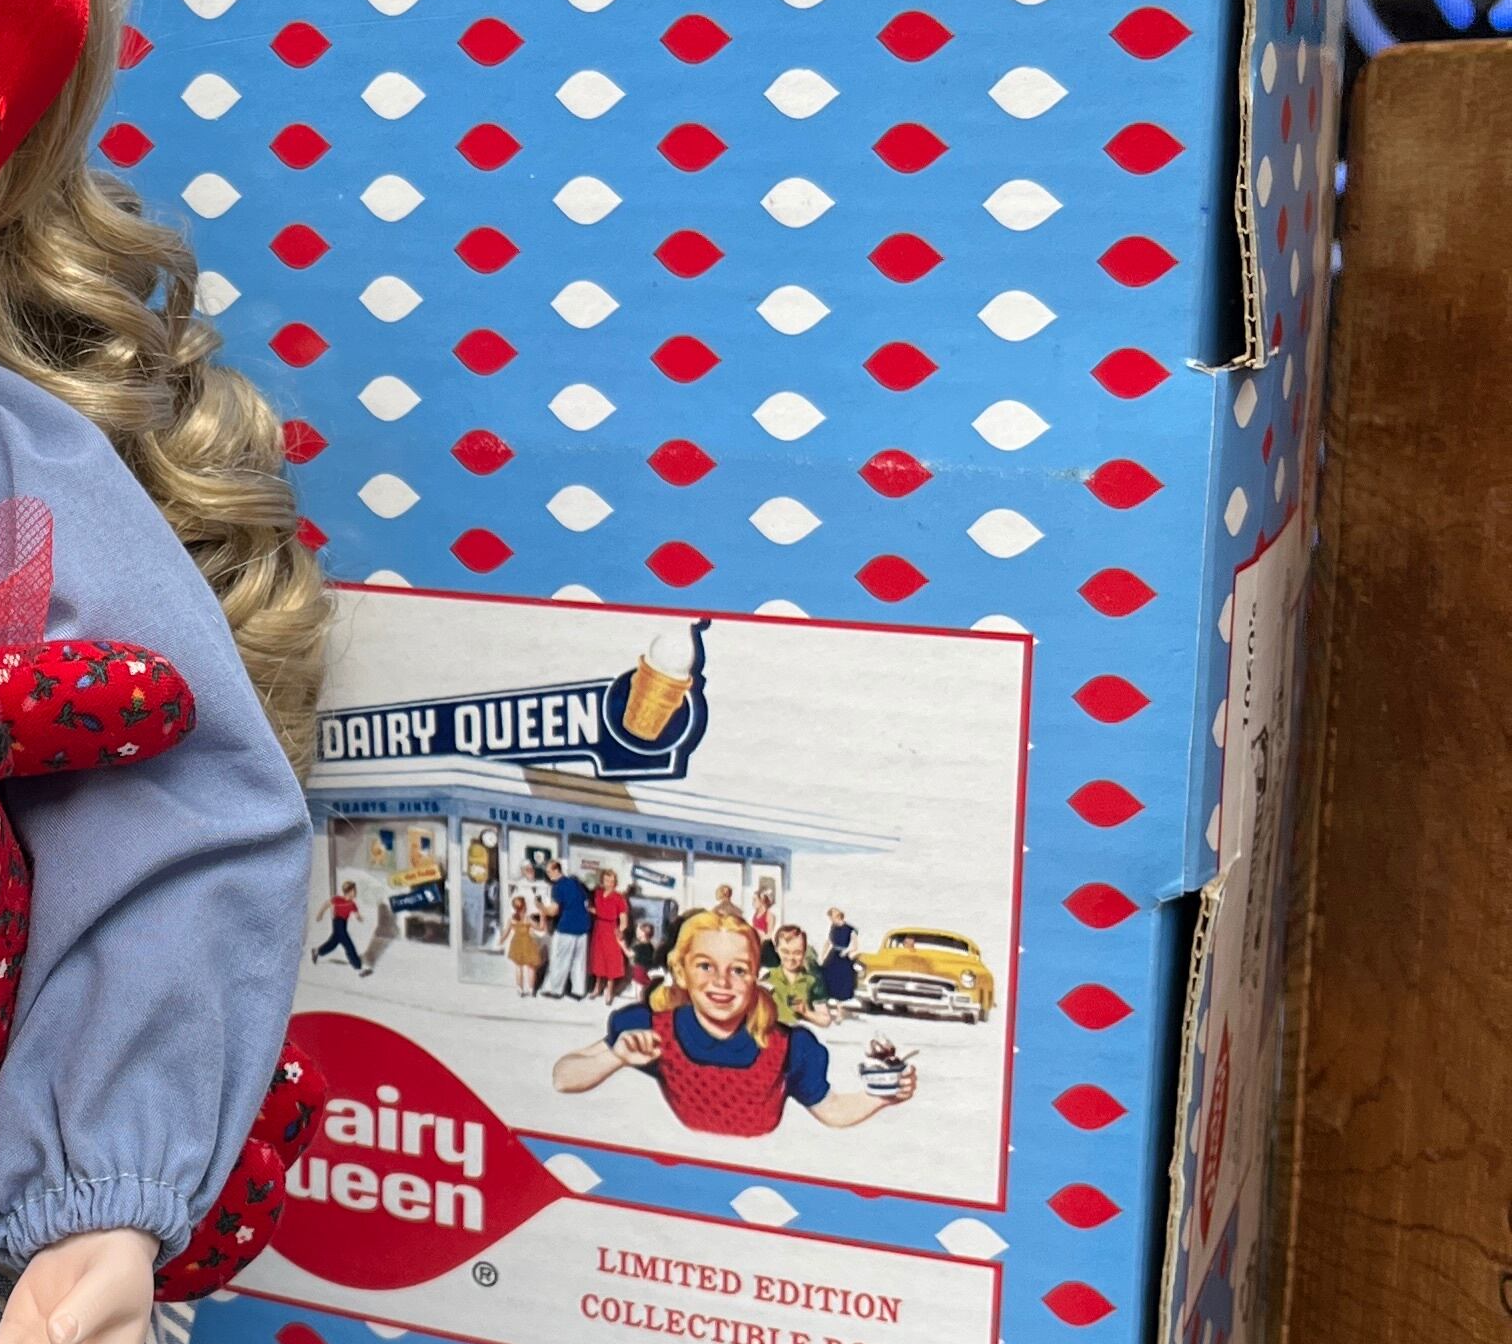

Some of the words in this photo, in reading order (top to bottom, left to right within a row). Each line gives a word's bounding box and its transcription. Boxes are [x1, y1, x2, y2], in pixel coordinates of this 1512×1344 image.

[320, 708, 437, 760] DAIRY
[453, 691, 600, 756] QUEEN
[488, 806, 566, 831] SUNDAES
[581, 820, 634, 840] CONES
[646, 831, 695, 851] MALTS
[704, 839, 764, 859] SHAKES
[323, 1084, 484, 1179] airy
[284, 1155, 484, 1233] ueen
[596, 1246, 743, 1296] LIMITED
[753, 1273, 903, 1324] EDITION
